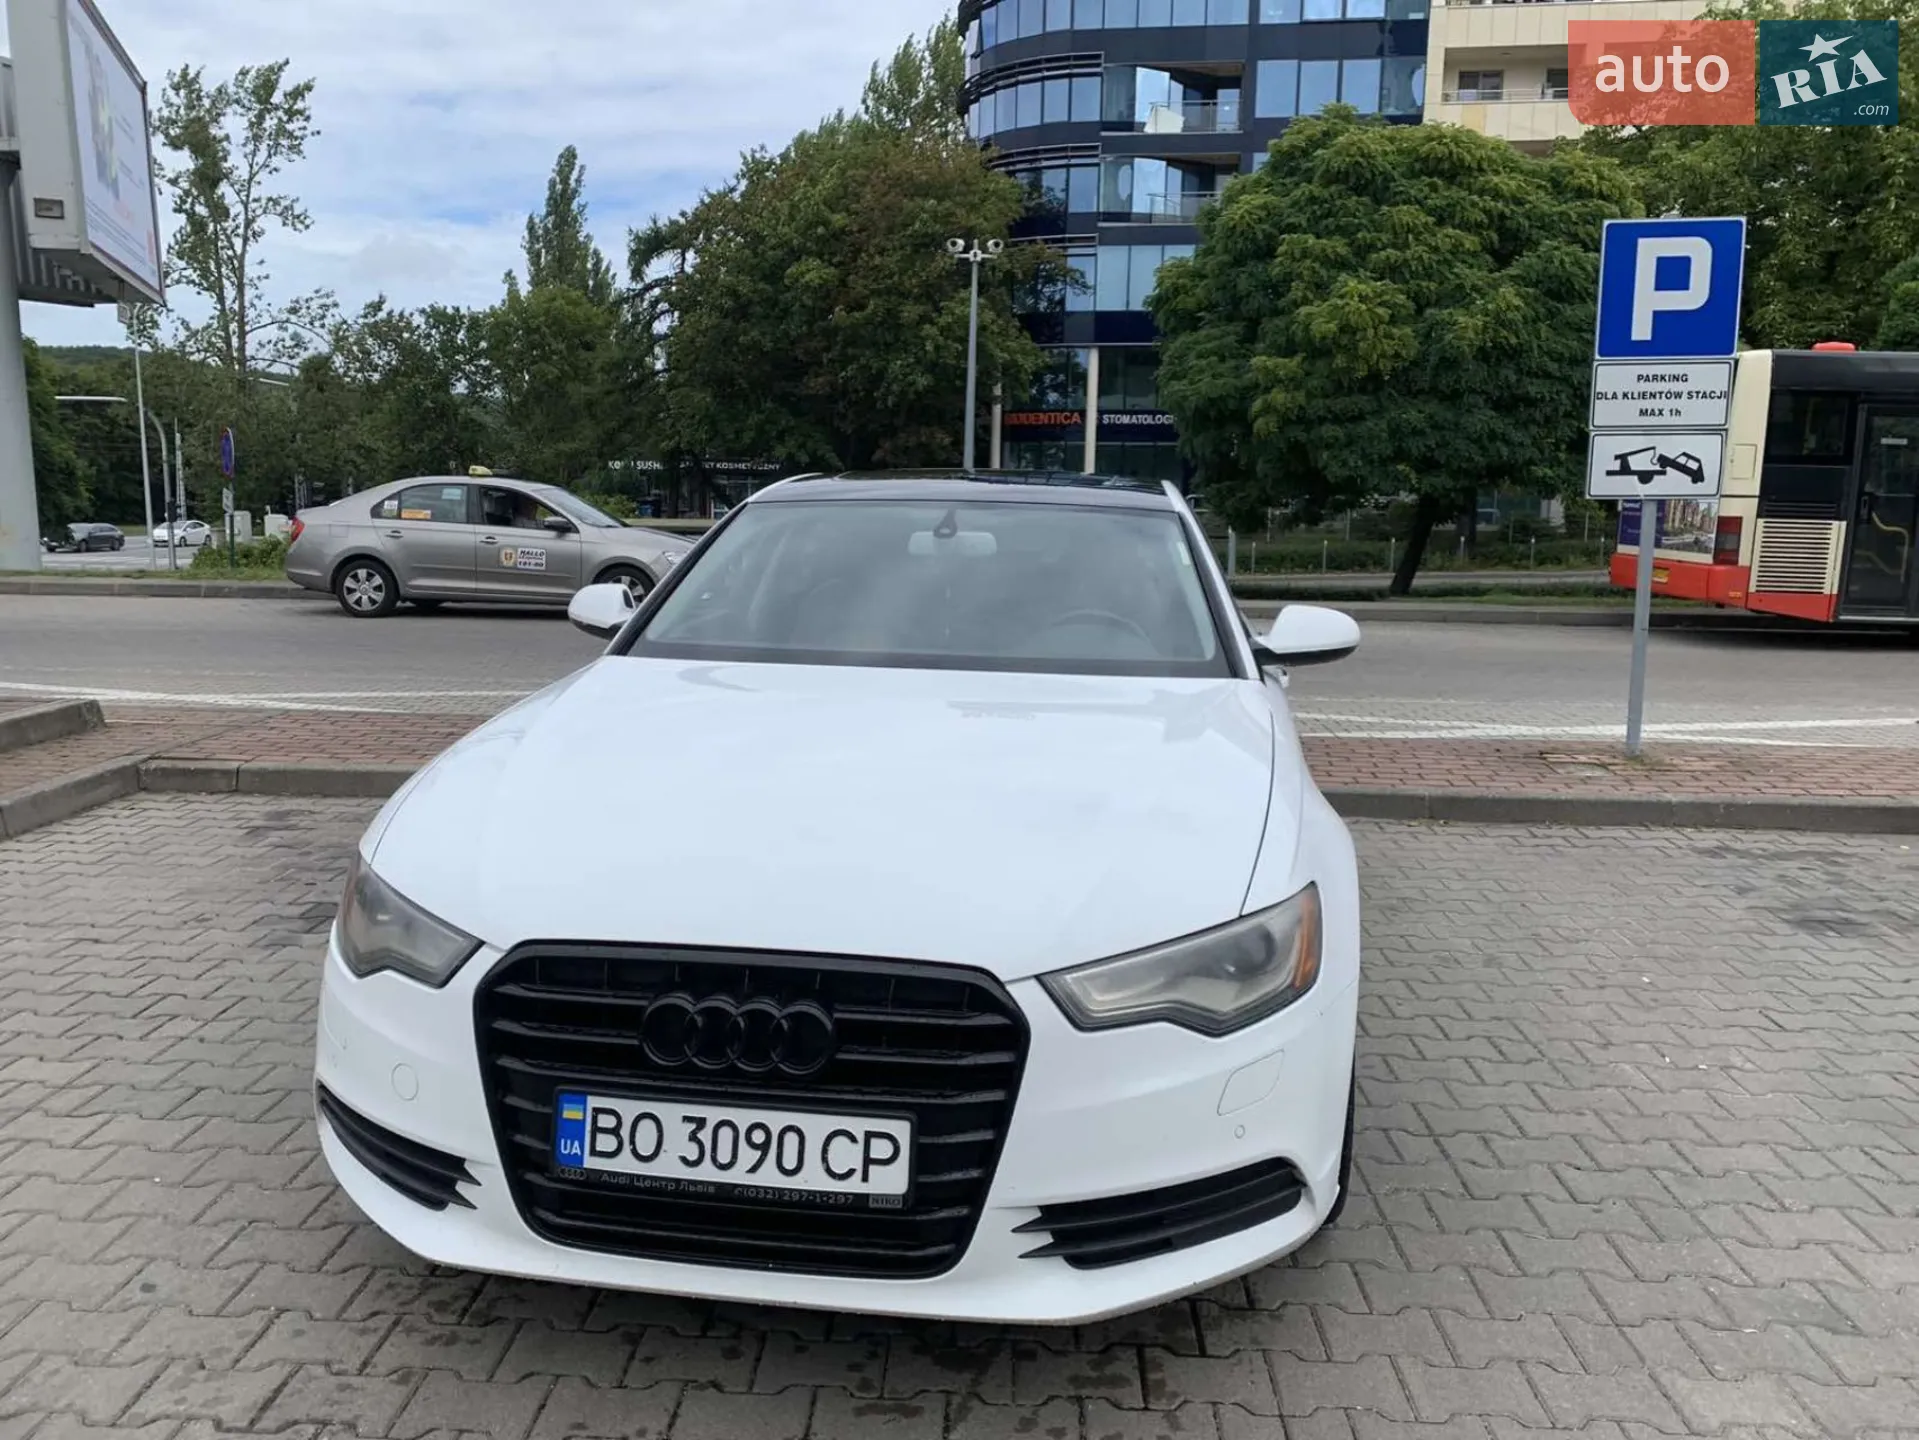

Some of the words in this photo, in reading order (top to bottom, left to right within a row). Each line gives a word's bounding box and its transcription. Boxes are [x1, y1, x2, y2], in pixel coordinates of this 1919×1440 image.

[1631, 236, 1713, 341] P
[1636, 373, 1689, 384] PARKING
[1596, 390, 1618, 401] DLA
[1621, 389, 1684, 401] KLIENTÓW
[1686, 390, 1727, 401] STACJI
[1638, 407, 1665, 417] MAX
[1669, 408, 1682, 417] 1h
[560, 1138, 582, 1156] UA
[589, 1106, 664, 1163] BO
[678, 1115, 806, 1178] 3090
[820, 1128, 901, 1183] CP
[600, 1173, 630, 1184] Audi
[633, 1175, 676, 1190] Центр
